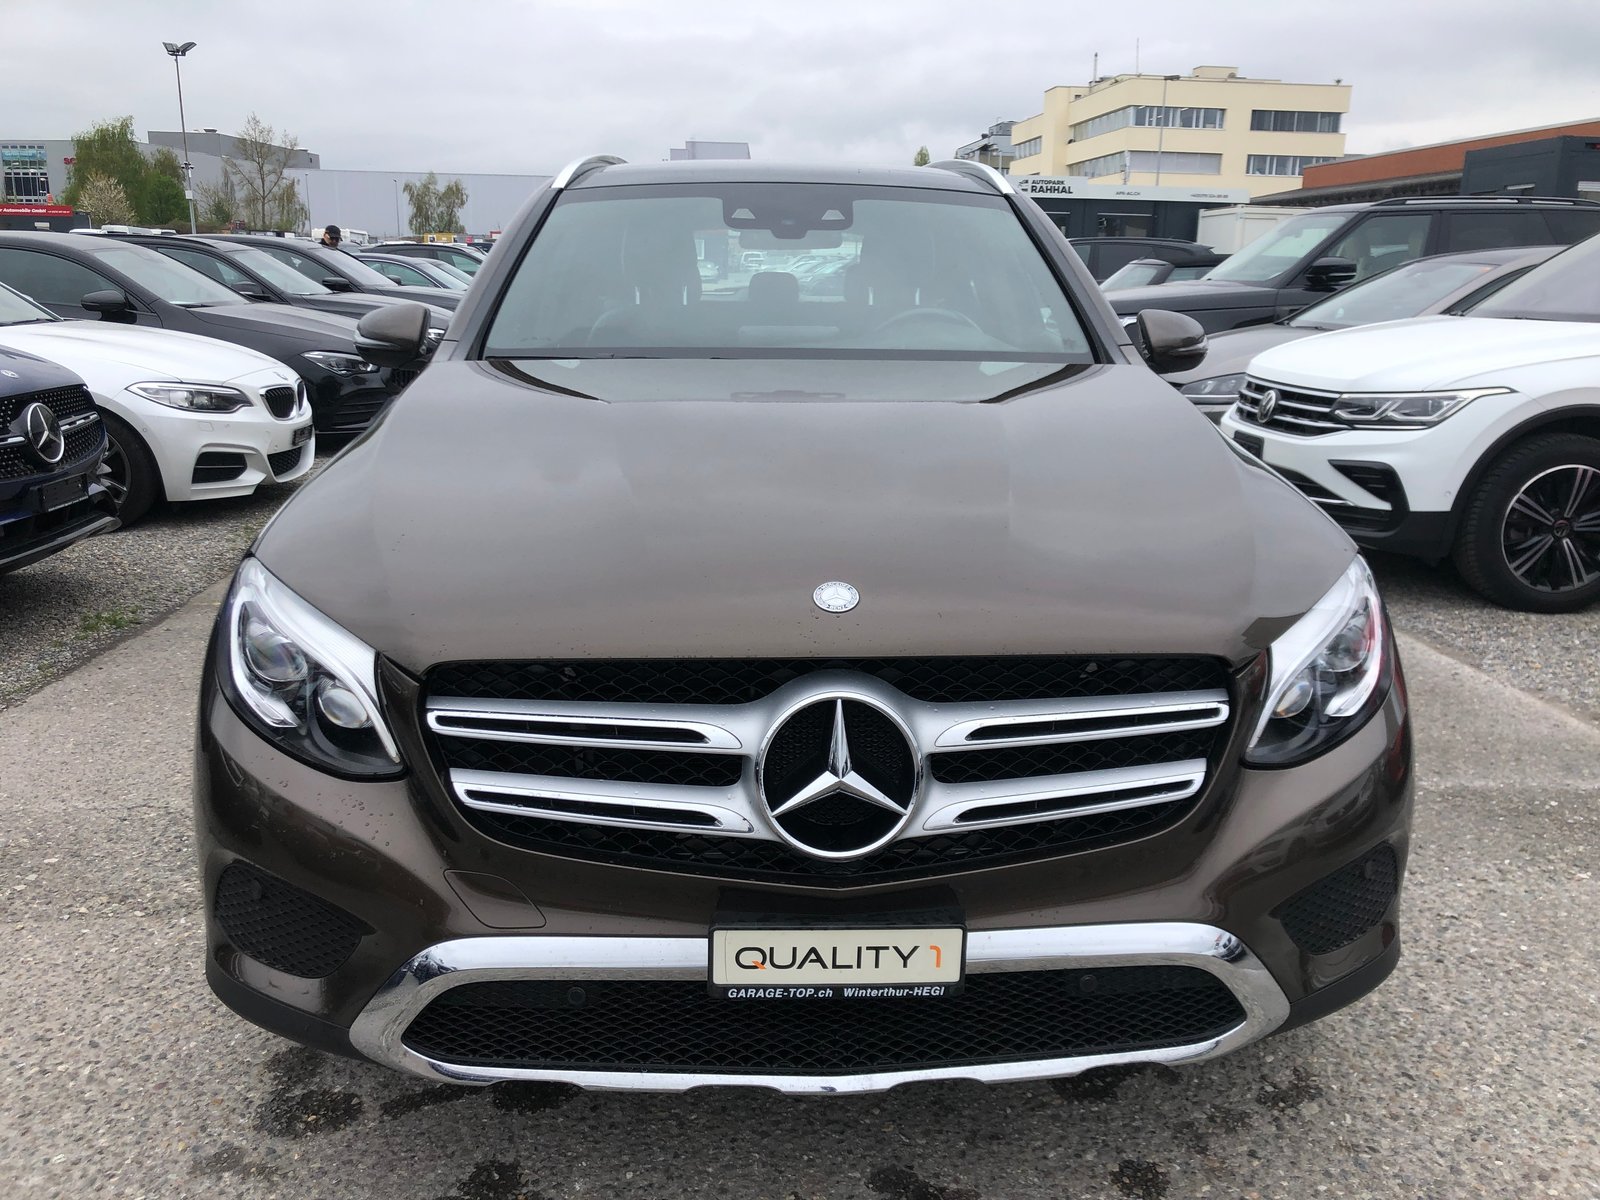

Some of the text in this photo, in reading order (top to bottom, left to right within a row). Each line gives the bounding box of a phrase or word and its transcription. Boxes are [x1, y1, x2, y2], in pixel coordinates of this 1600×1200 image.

[1030, 185, 1074, 194] RAHHAL
[734, 945, 942, 970] QUALITY 1
[727, 986, 945, 999] GARAGE-TOP.ch Winterthur-HEGI
